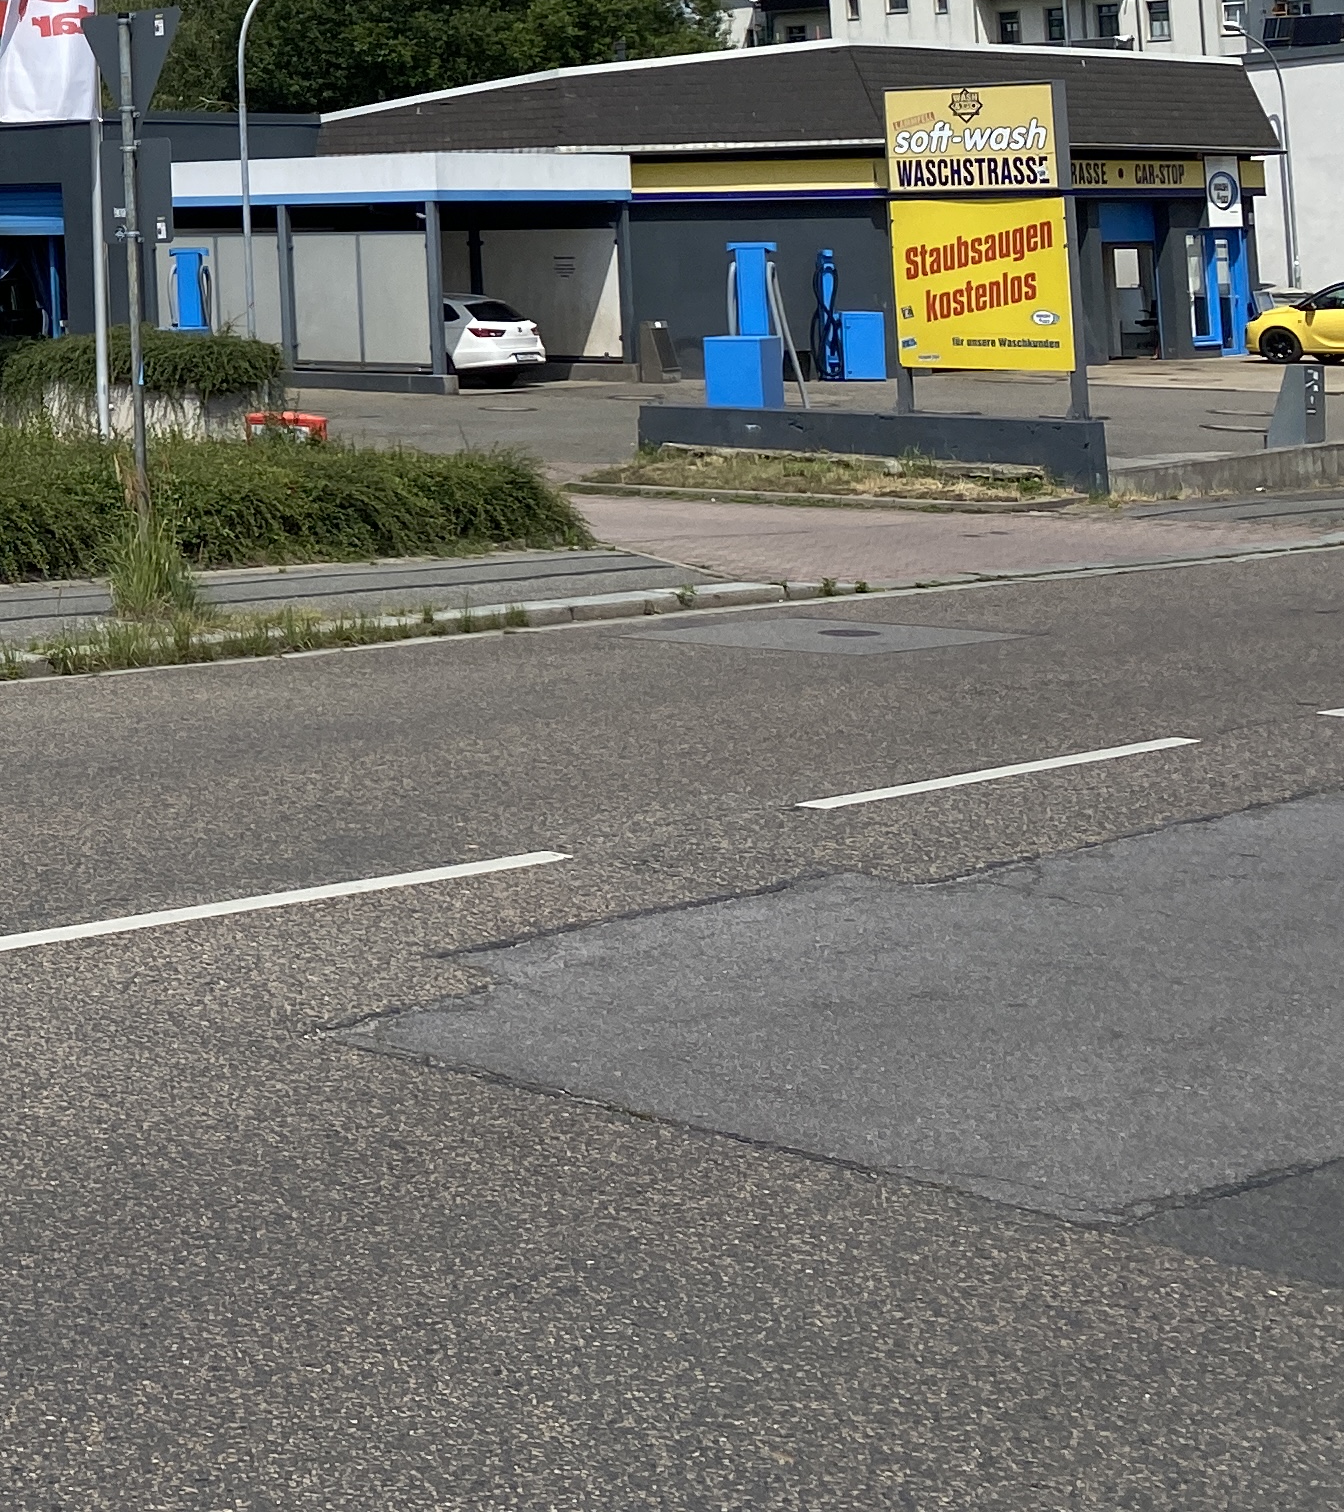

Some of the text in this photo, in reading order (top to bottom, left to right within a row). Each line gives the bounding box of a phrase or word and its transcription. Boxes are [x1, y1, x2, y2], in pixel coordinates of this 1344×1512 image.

[894, 116, 1048, 155] soft-wash
[905, 220, 1053, 281] Staubsaugen
[925, 272, 1038, 323] kostenlos
[998, 337, 1061, 349] Waschkunden
